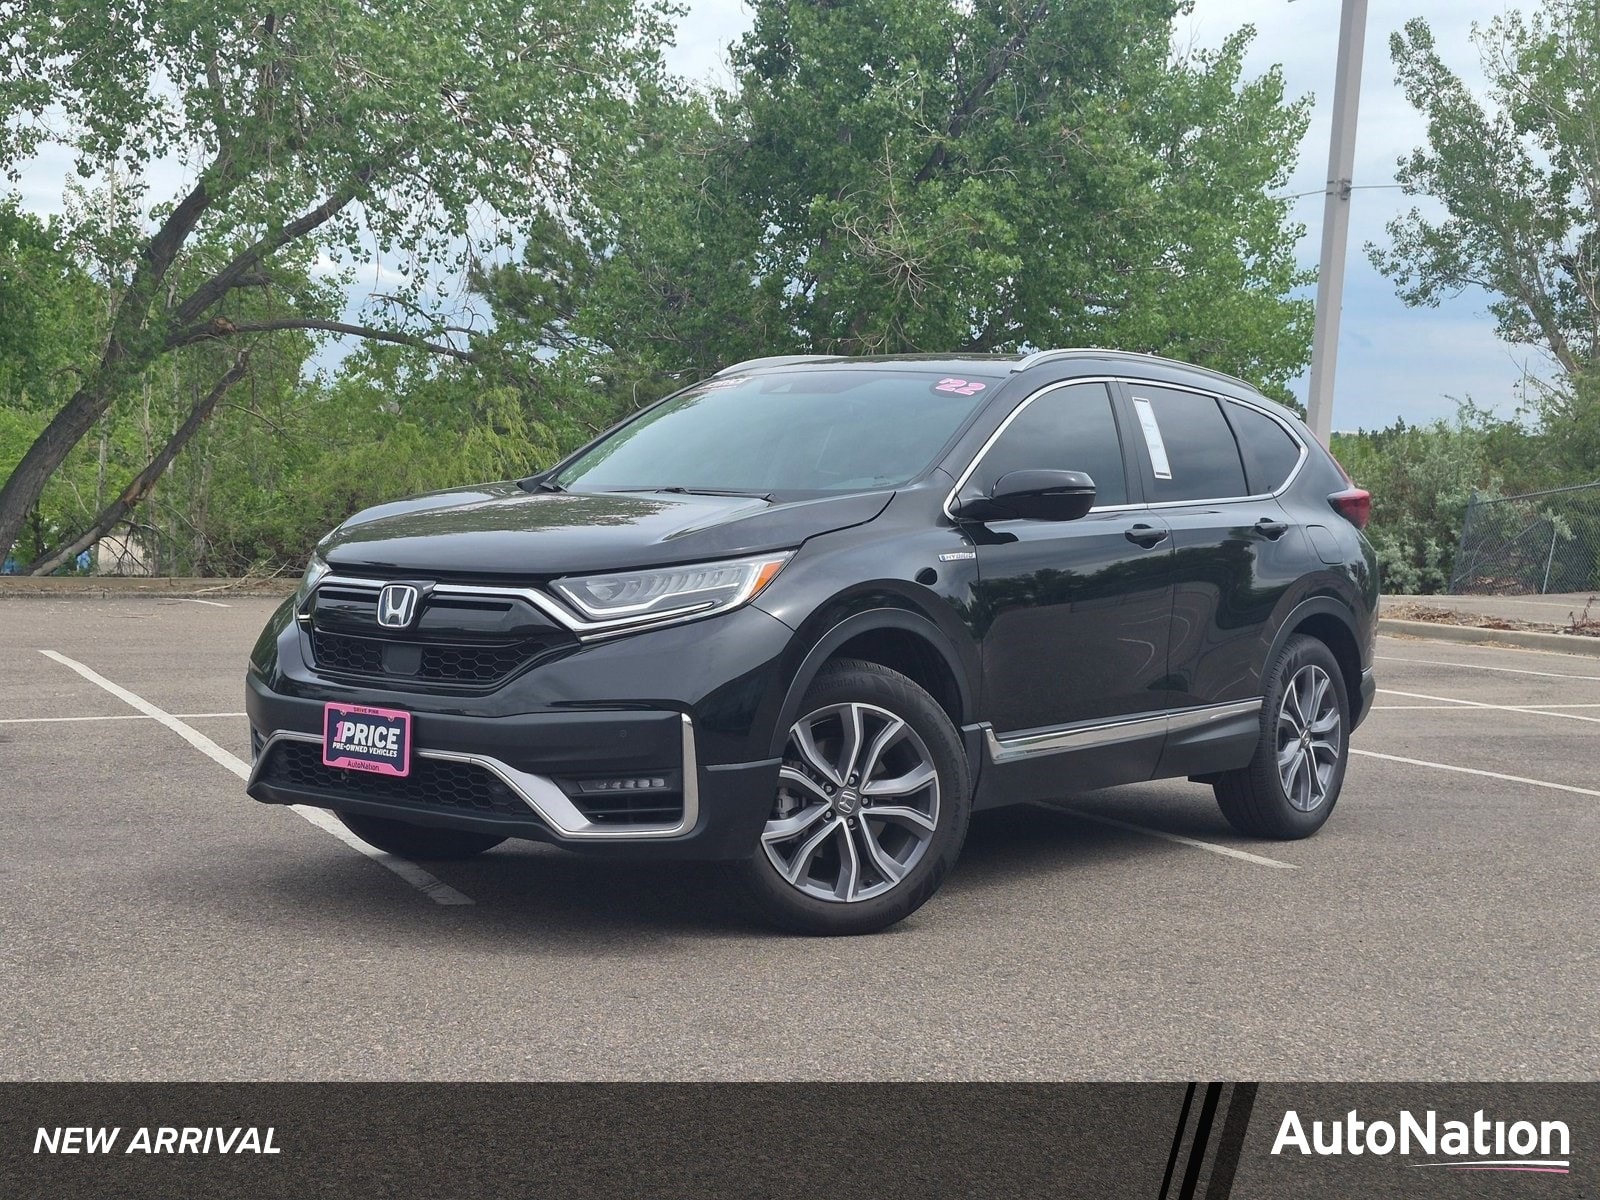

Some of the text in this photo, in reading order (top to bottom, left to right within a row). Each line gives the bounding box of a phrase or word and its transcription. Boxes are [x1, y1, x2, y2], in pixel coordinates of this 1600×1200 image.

[332, 742, 398, 758] PRE-OWNED VEHICLES
[347, 760, 380, 772] AutoNation
